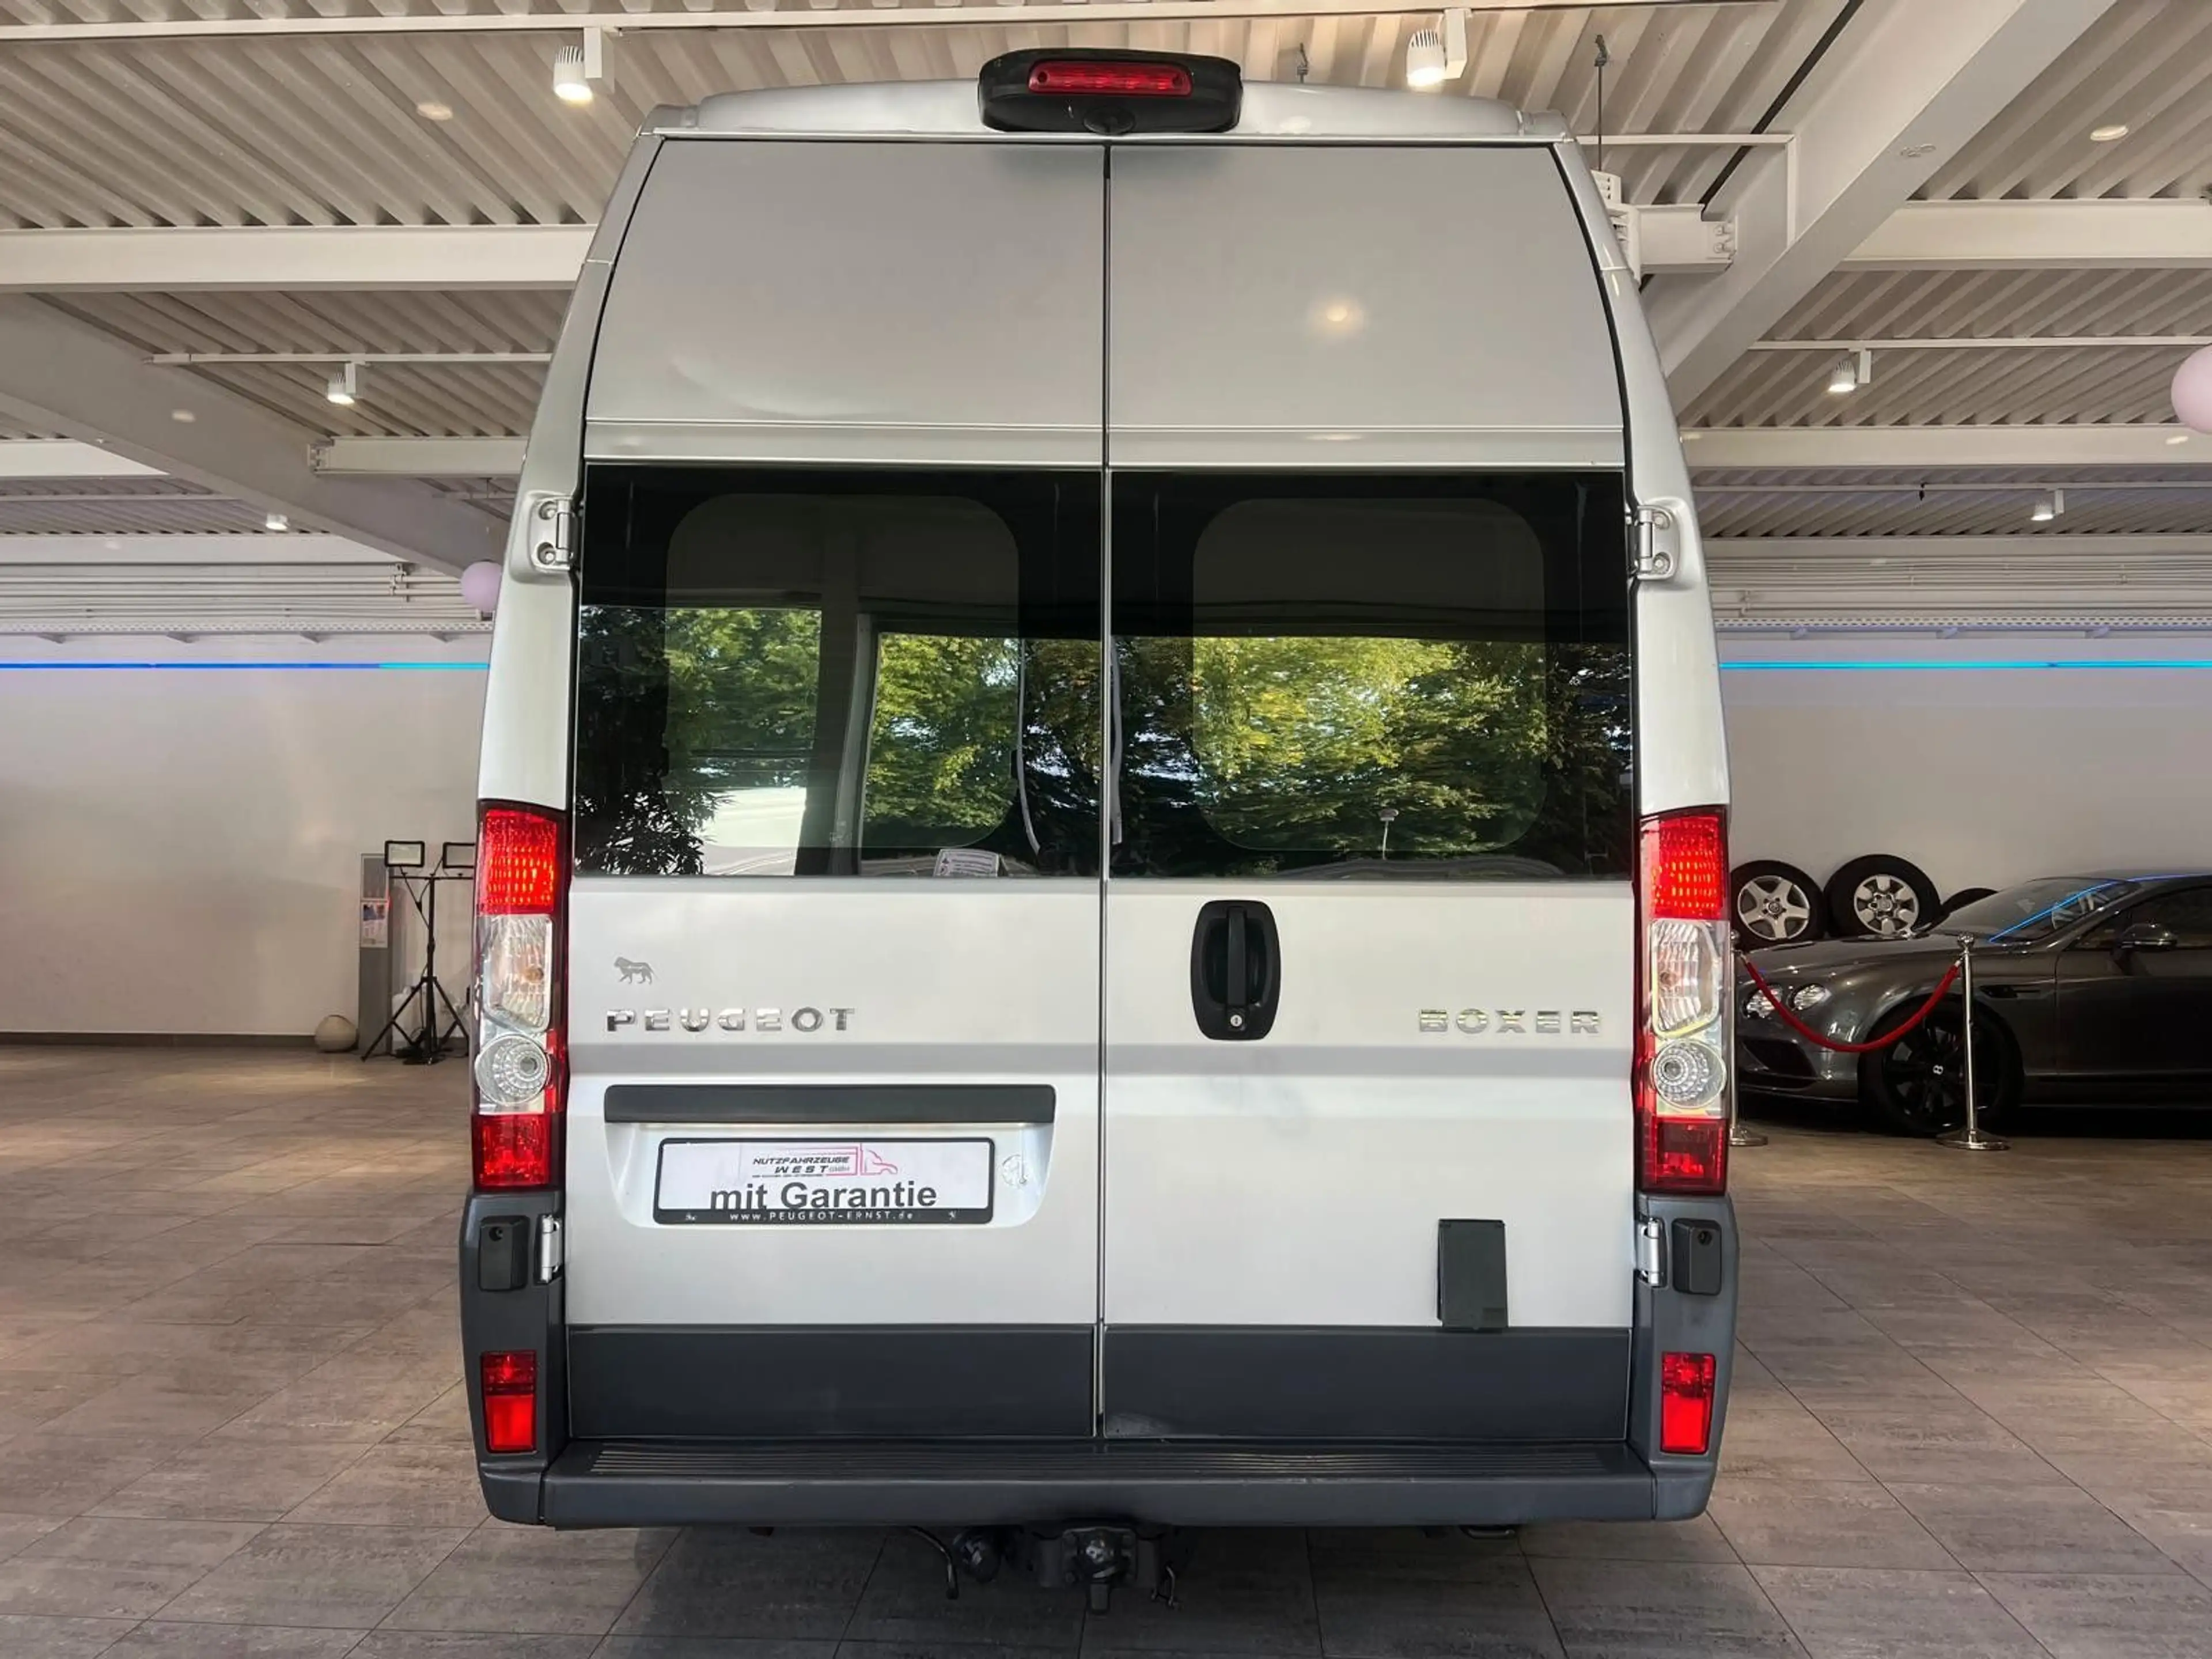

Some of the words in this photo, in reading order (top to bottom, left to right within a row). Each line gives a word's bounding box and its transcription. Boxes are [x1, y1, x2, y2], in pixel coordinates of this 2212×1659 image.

[607, 1006, 855, 1032] PEUGEOT
[1419, 1008, 1599, 1033] BOXER
[752, 1156, 850, 1164] NUTZFAHRZEUGE
[710, 1183, 768, 1210] mit
[781, 1181, 937, 1209] Garantie
[730, 1211, 914, 1220] www.PEUGEOT-ERNST.de
